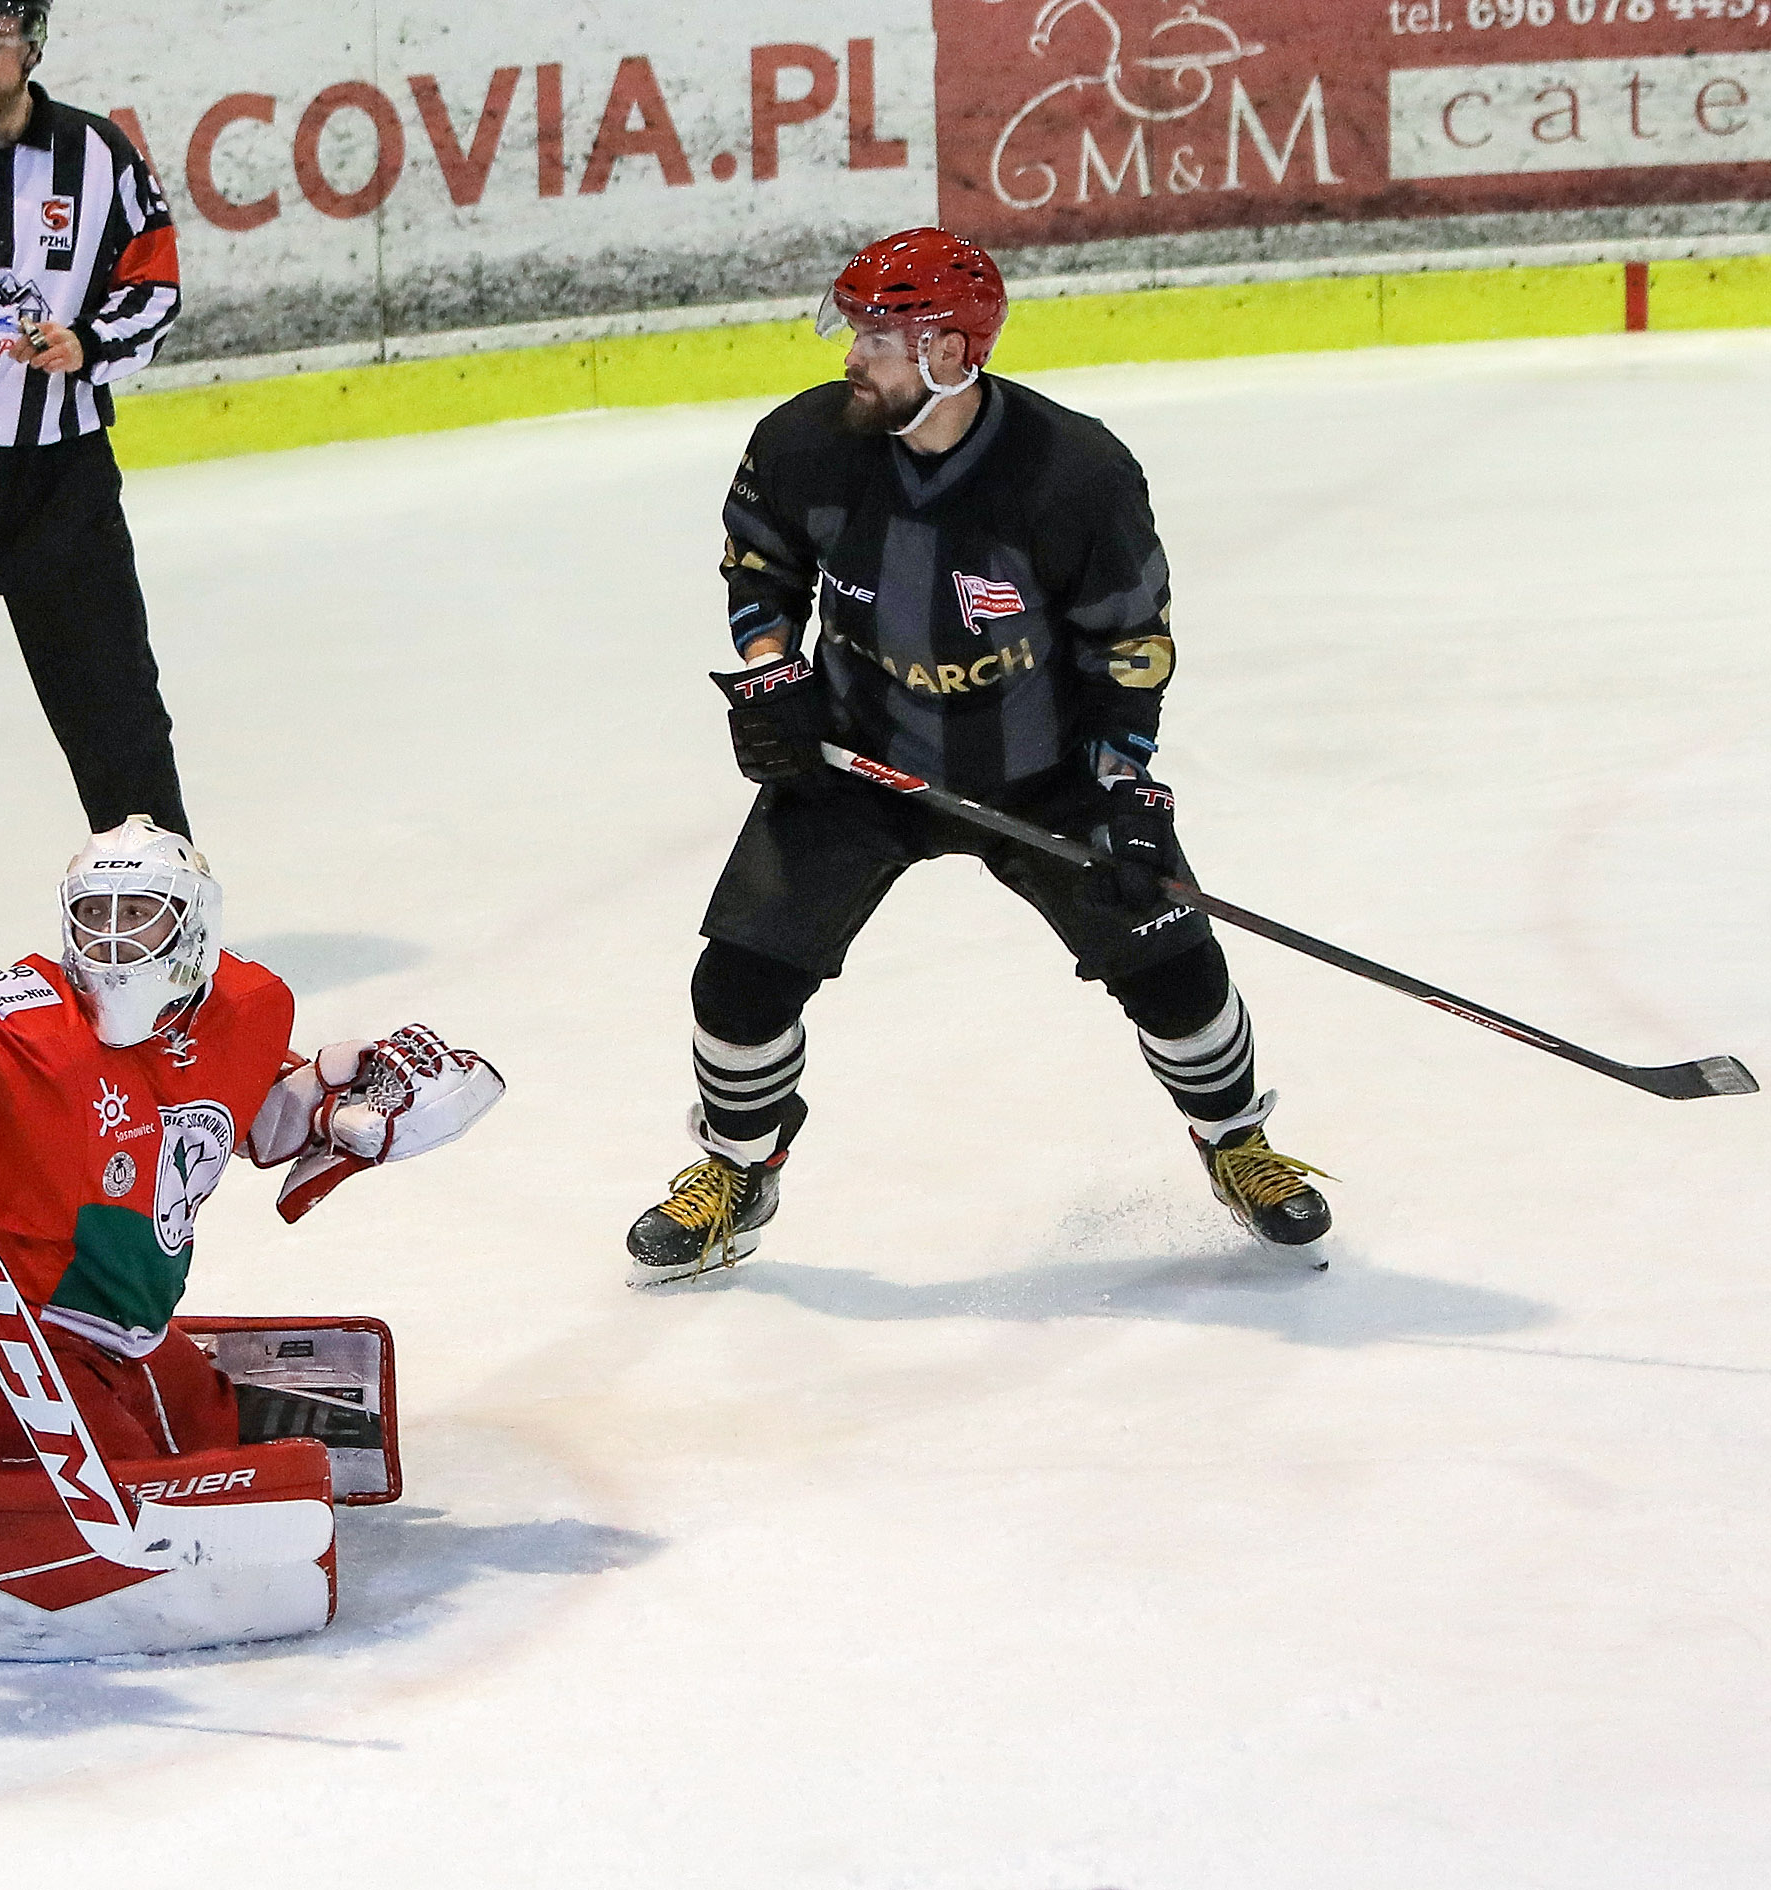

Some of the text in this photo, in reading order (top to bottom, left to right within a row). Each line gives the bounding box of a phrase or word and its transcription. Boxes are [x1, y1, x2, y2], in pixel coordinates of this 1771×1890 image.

[1388, 0, 1454, 35] tel.
[39, 235, 72, 248] PZHL
[912, 309, 955, 322] TRUE
[882, 637, 1035, 695] ARCH
[93, 860, 144, 870] CCM
[114, 1122, 156, 1144] Sosnowiec
